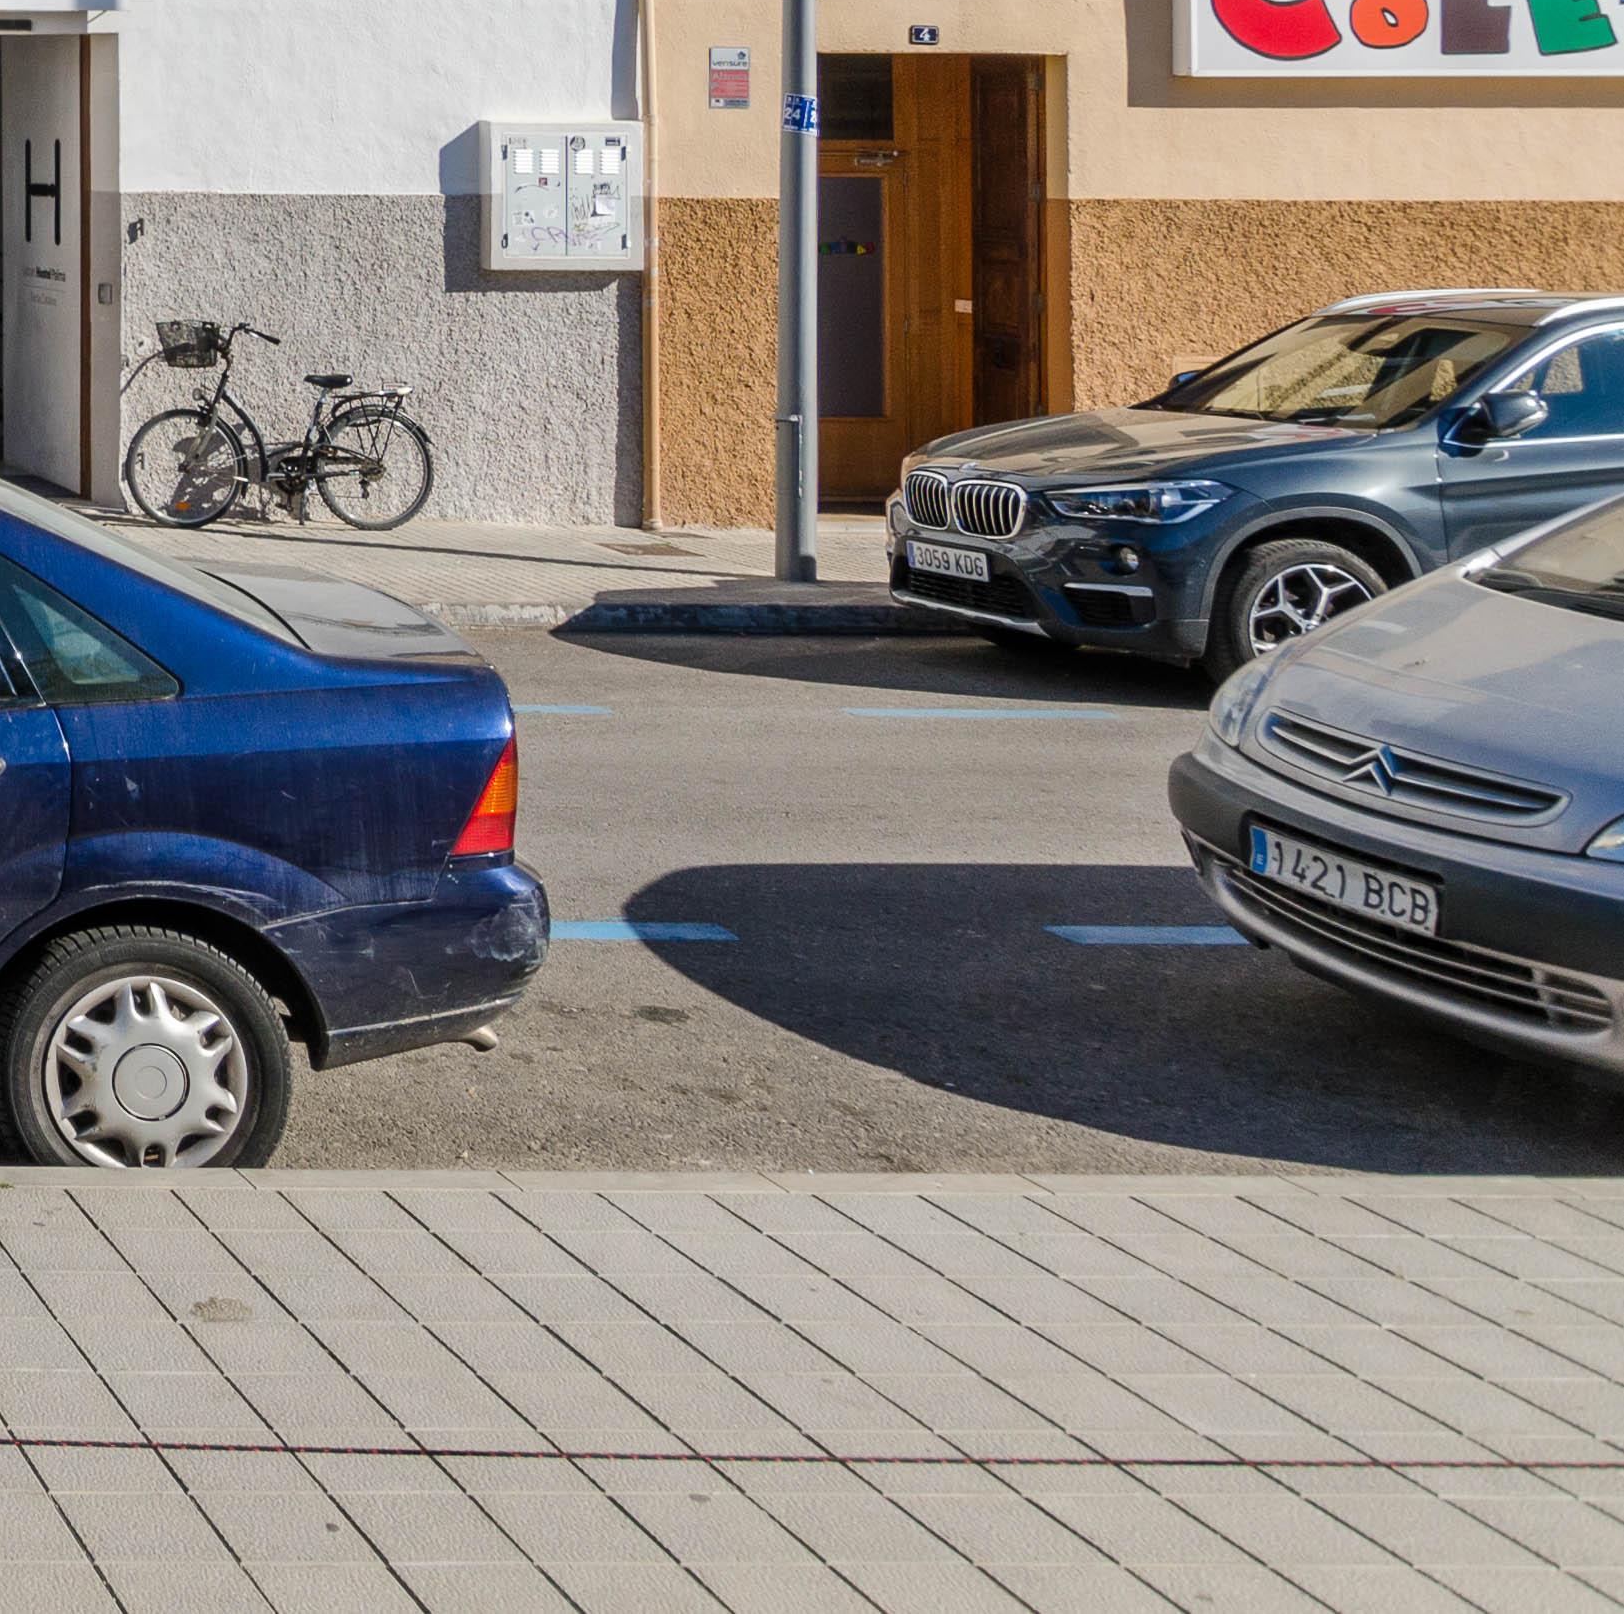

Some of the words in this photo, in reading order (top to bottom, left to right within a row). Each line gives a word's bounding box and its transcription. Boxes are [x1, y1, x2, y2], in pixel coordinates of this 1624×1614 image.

[919, 27, 931, 42] 4
[916, 546, 951, 571] 3059
[954, 553, 984, 577] KDG
[1272, 840, 1347, 900] 1421
[1362, 871, 1431, 926] BCB
